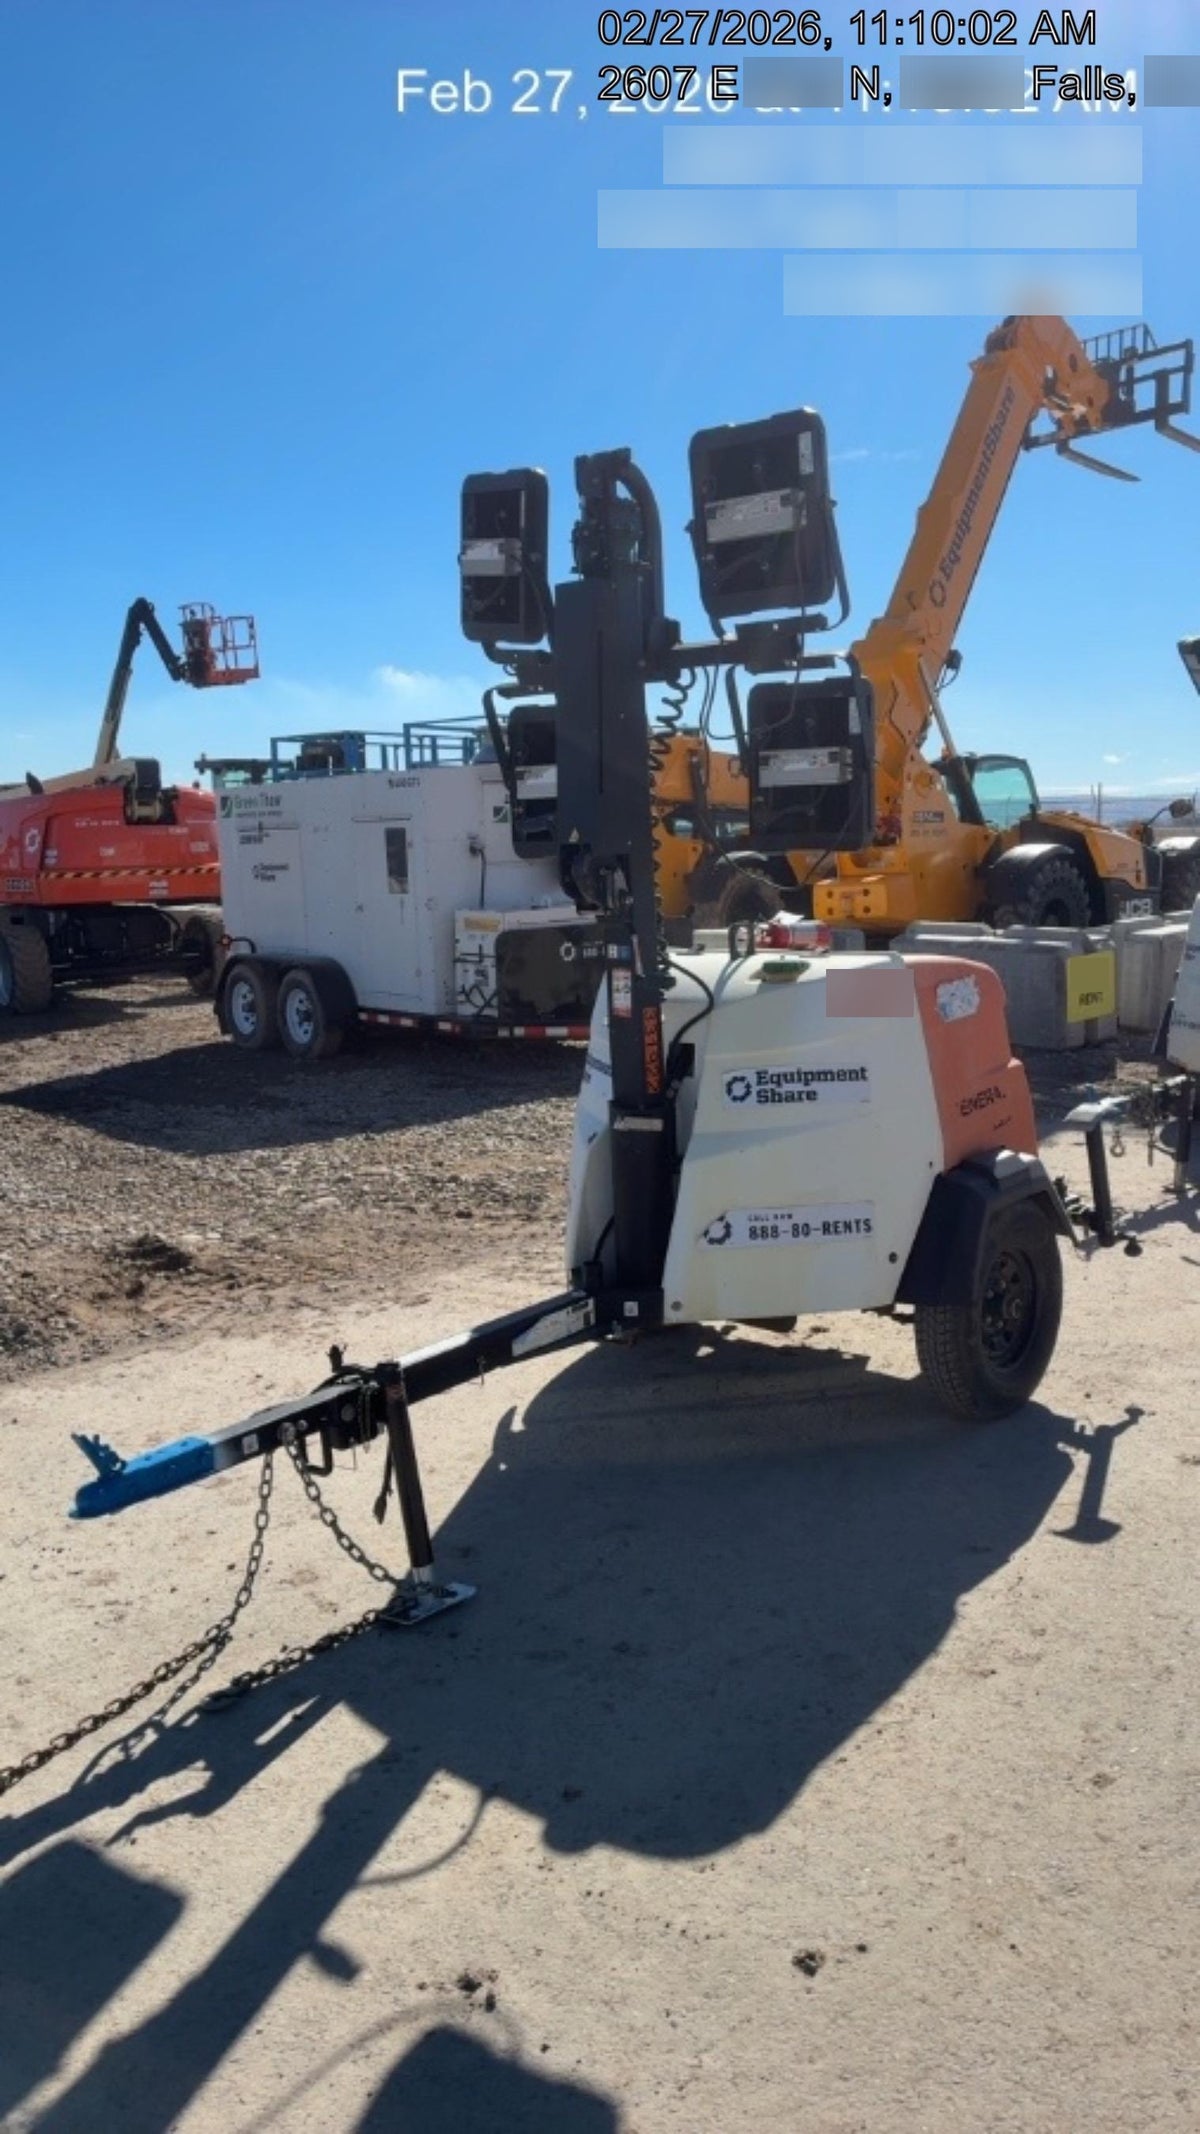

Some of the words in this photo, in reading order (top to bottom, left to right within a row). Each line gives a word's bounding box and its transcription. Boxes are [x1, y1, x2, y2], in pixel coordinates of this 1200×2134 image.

[755, 1066, 869, 1088] Equipment
[755, 1088, 818, 1104] Share
[748, 1218, 872, 1241] 888-80-RENTS
